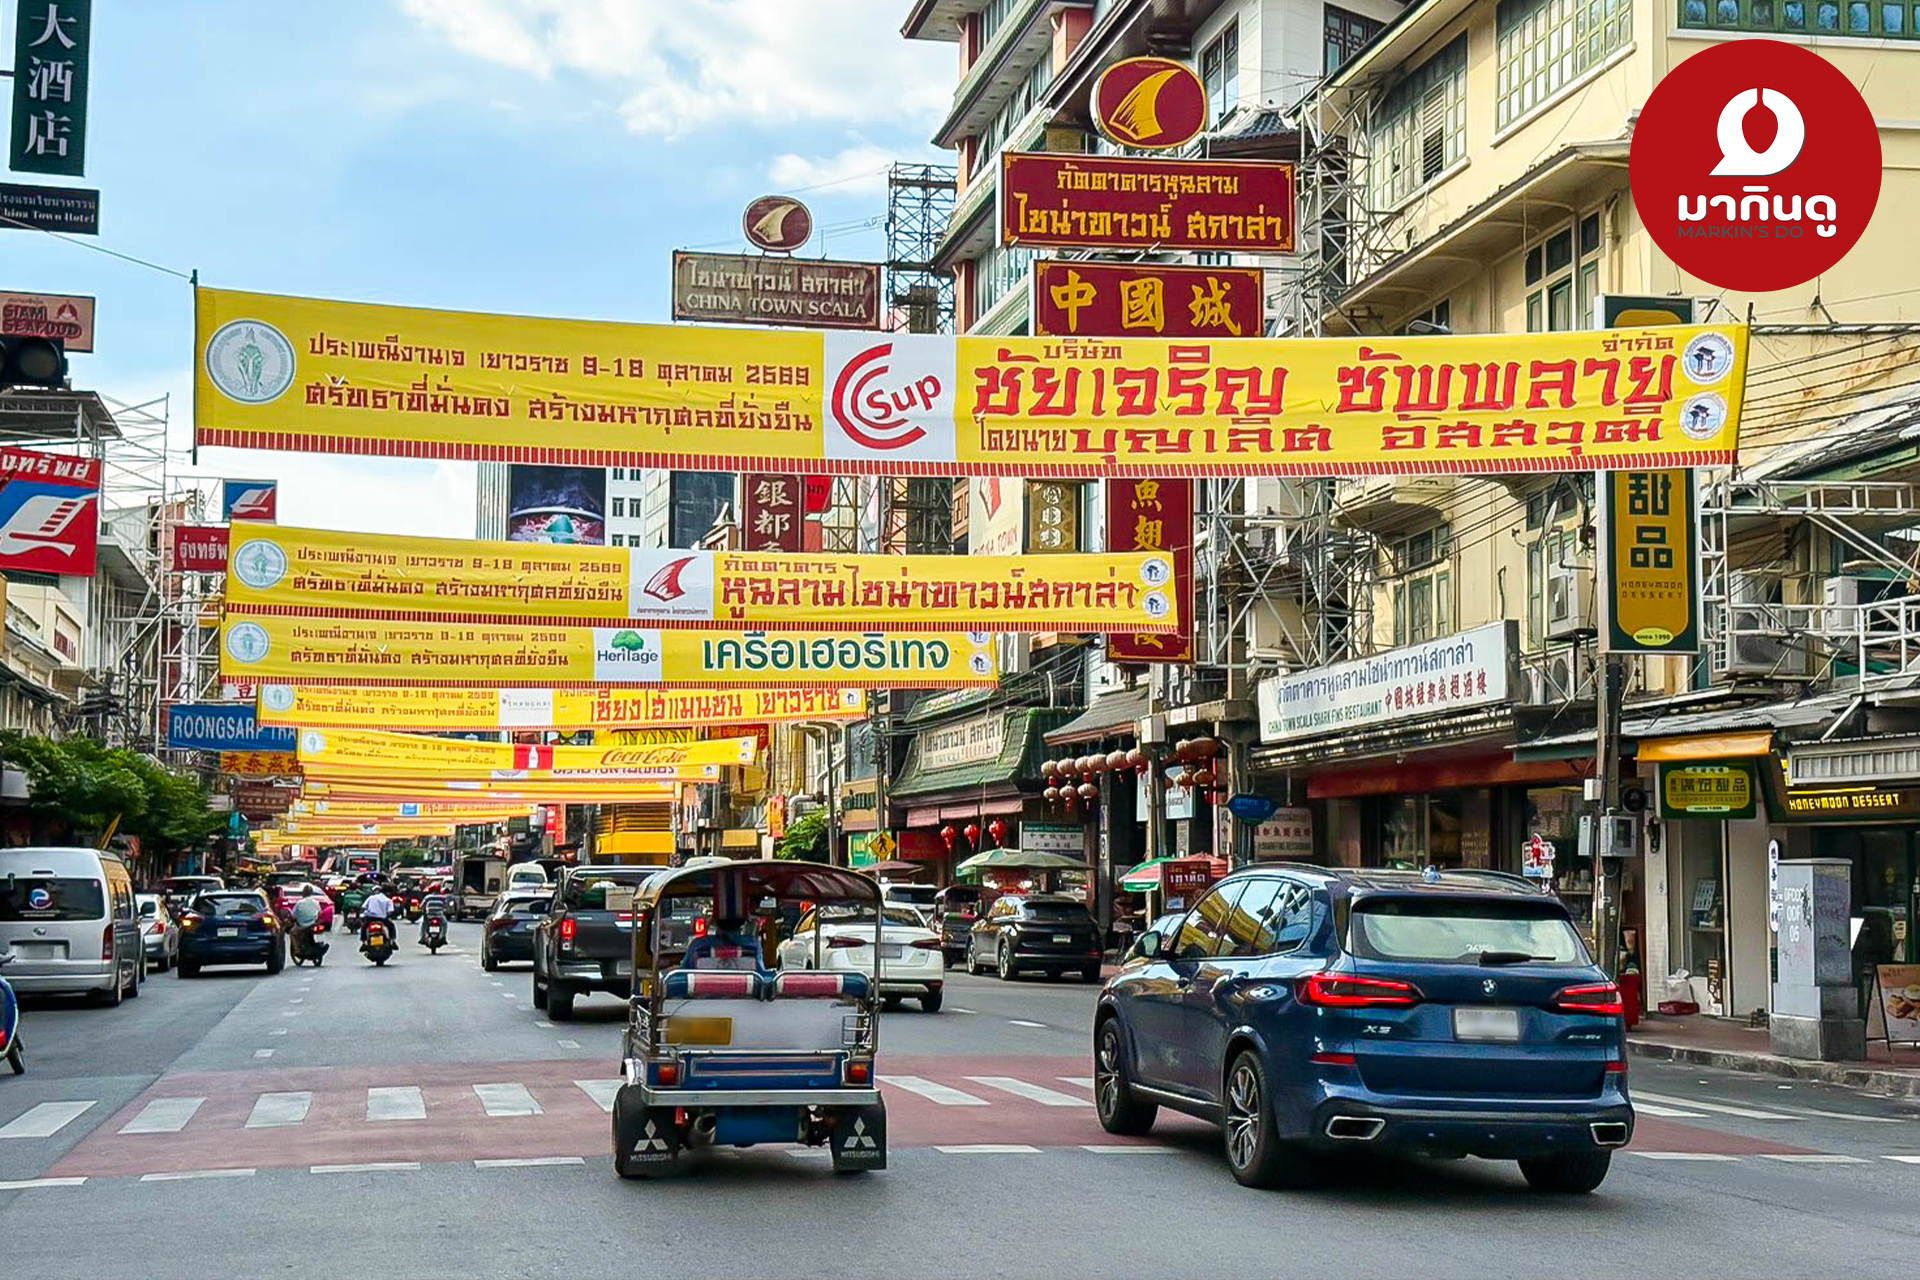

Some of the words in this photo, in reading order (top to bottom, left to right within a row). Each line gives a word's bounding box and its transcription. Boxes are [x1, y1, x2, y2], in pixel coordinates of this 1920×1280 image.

[25, 4, 77, 157] 大酒店
[1057, 162, 1239, 201] ภัตตาคารหูฉลาม
[1013, 193, 1172, 239] ไชน่าทาวน์
[1187, 204, 1283, 241] สกาล่า
[801, 271, 865, 296] สกาล่า
[3, 304, 47, 320] SIAM
[687, 293, 742, 311] CHINA
[749, 296, 803, 315] TOWN
[807, 301, 867, 319] SCALA
[1050, 269, 1242, 336] 中國城
[1043, 339, 1122, 359] บริษัท
[1602, 333, 1674, 353] จำกัด
[480, 352, 568, 375] เยาวราช
[658, 364, 732, 387] ตุลาคม
[972, 344, 1290, 418] ชัยเจริญ
[521, 560, 571, 575] ตุลาคม
[724, 554, 837, 574] ภัตตาคาร
[597, 649, 659, 665] Heritage
[1297, 714, 1313, 729] SCALA
[1314, 710, 1332, 726] SHARK
[1344, 700, 1382, 721] RESTAURANT
[1789, 795, 1850, 811] HONEYMOON
[1851, 793, 1900, 808] DESSERT
